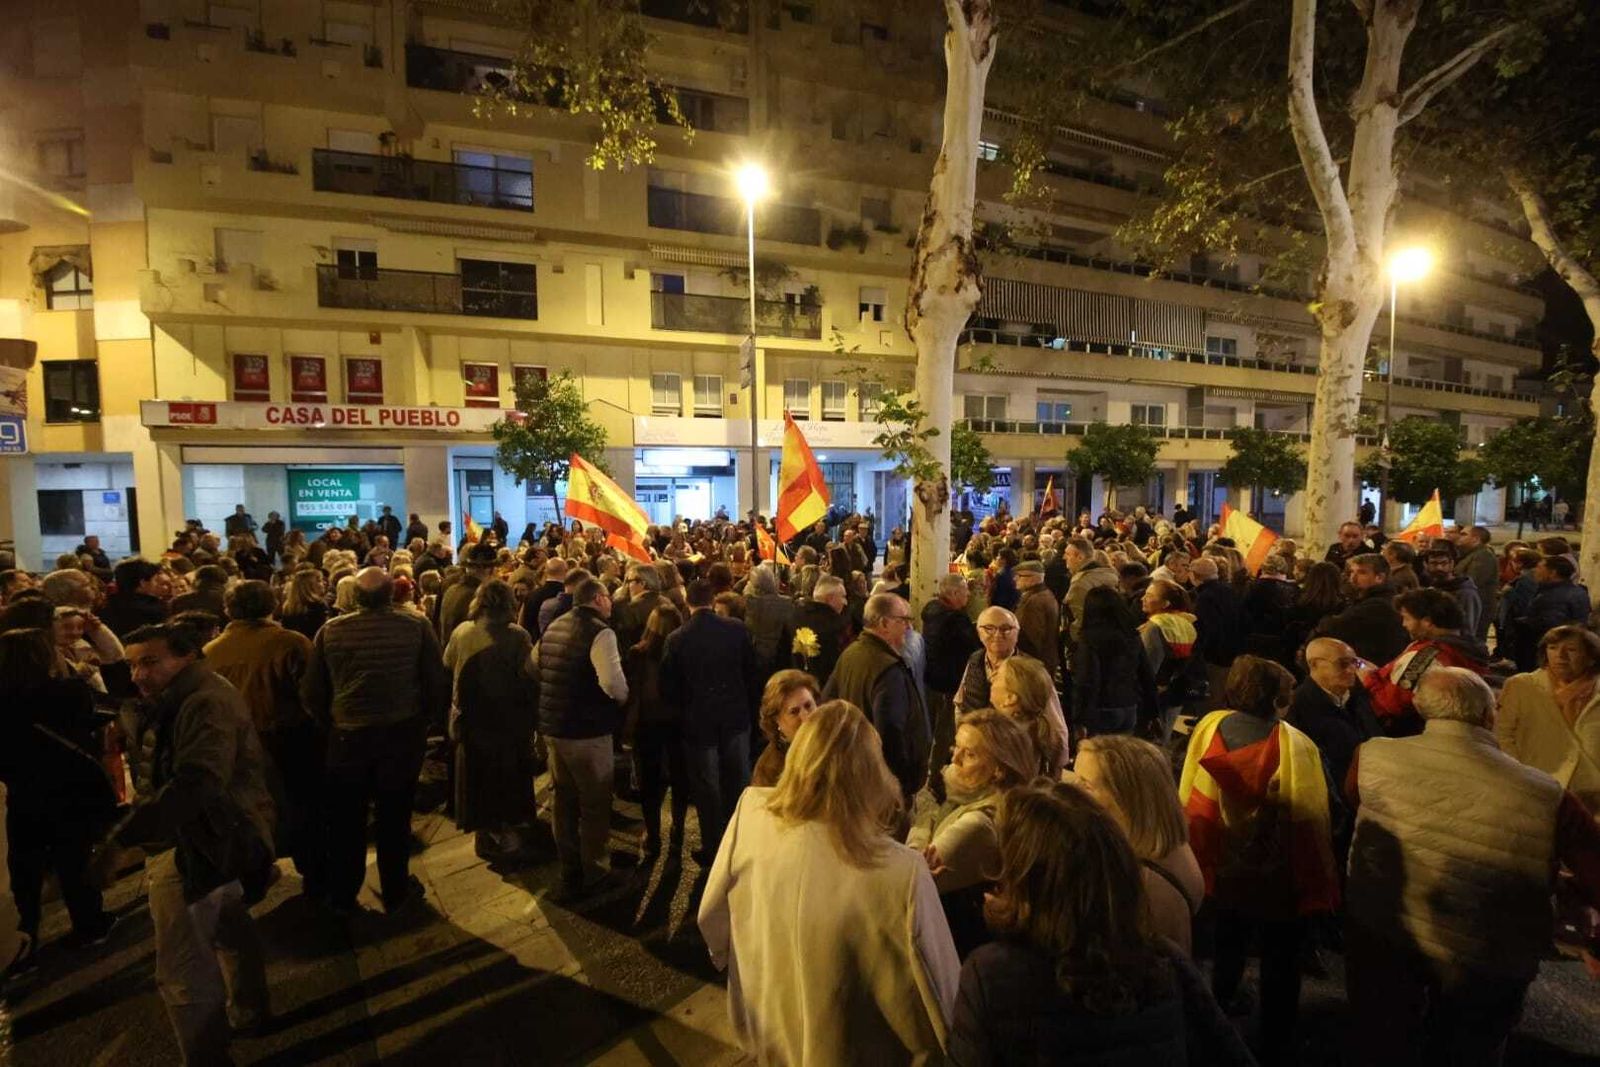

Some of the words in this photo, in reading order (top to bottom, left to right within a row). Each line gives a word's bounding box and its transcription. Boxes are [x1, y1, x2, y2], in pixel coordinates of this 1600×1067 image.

[265, 406, 325, 424] CASA
[332, 408, 372, 425] DEL
[378, 409, 460, 426] PUEBLO
[307, 478, 342, 487] LOCAL
[298, 489, 313, 498] EN
[317, 489, 353, 498] VENTA
